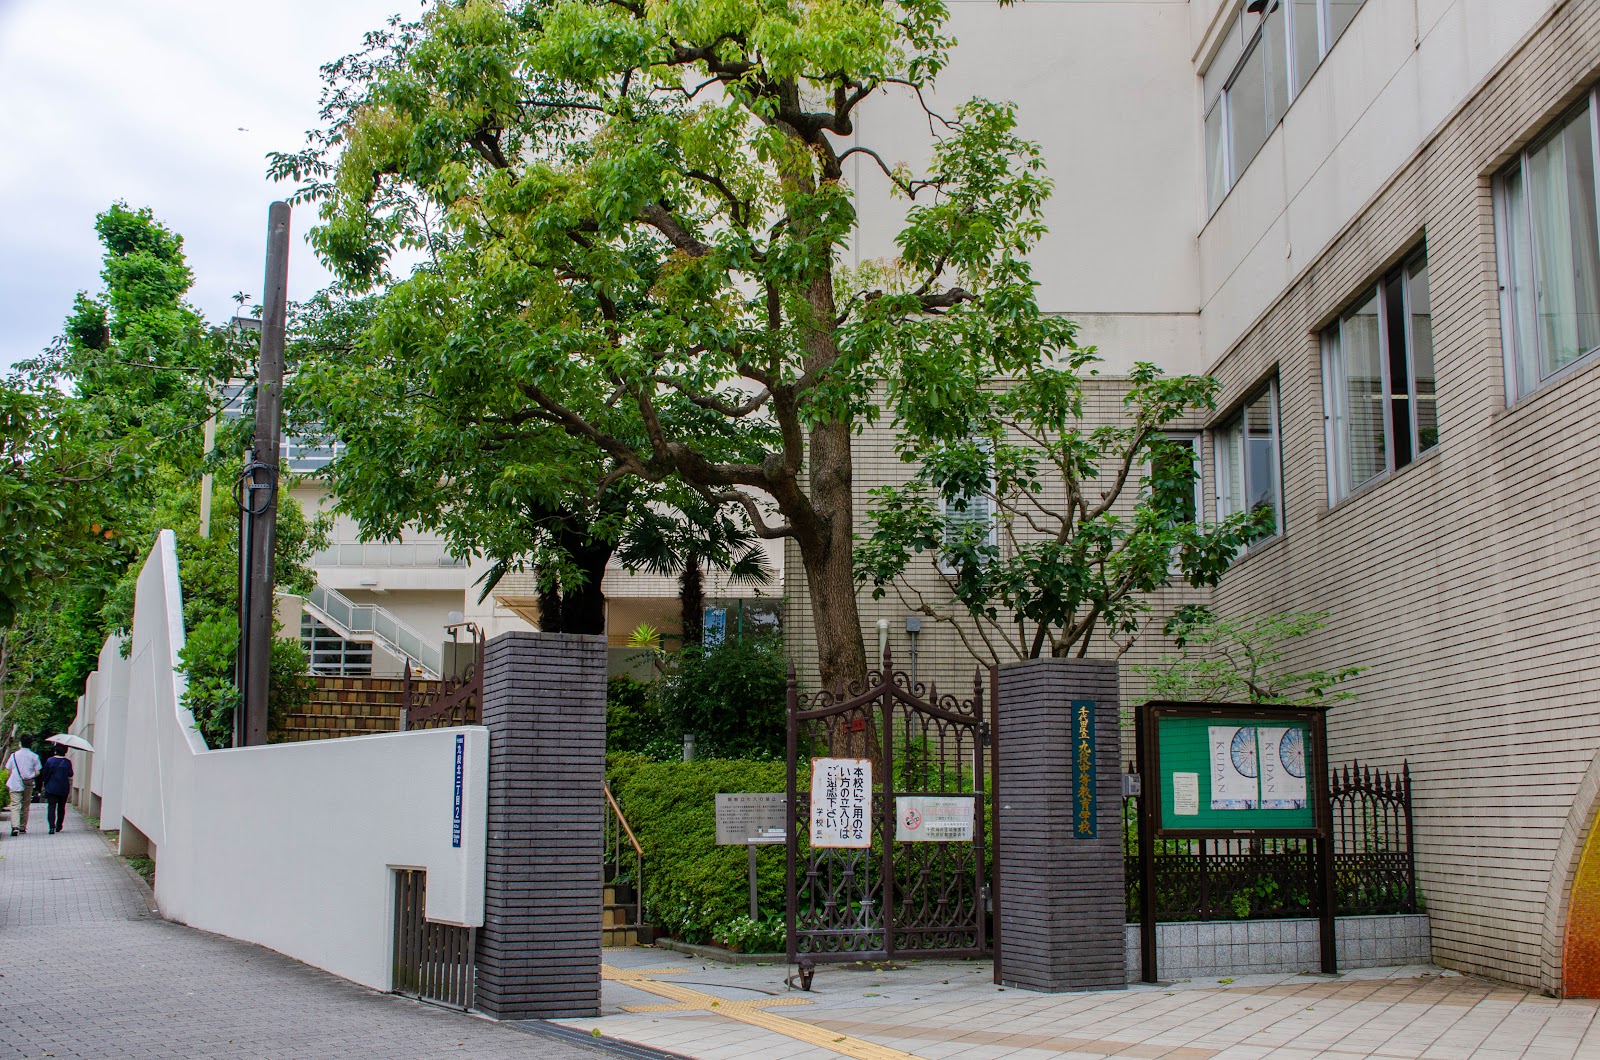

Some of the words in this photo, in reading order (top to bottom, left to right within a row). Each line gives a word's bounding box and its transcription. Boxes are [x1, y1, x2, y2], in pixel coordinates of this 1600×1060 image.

[1216, 741, 1226, 793] KUDAN
[1265, 742, 1275, 793] KUDAN
[839, 766, 851, 840] い方の立入りは
[852, 766, 866, 840] 本校にご用のな
